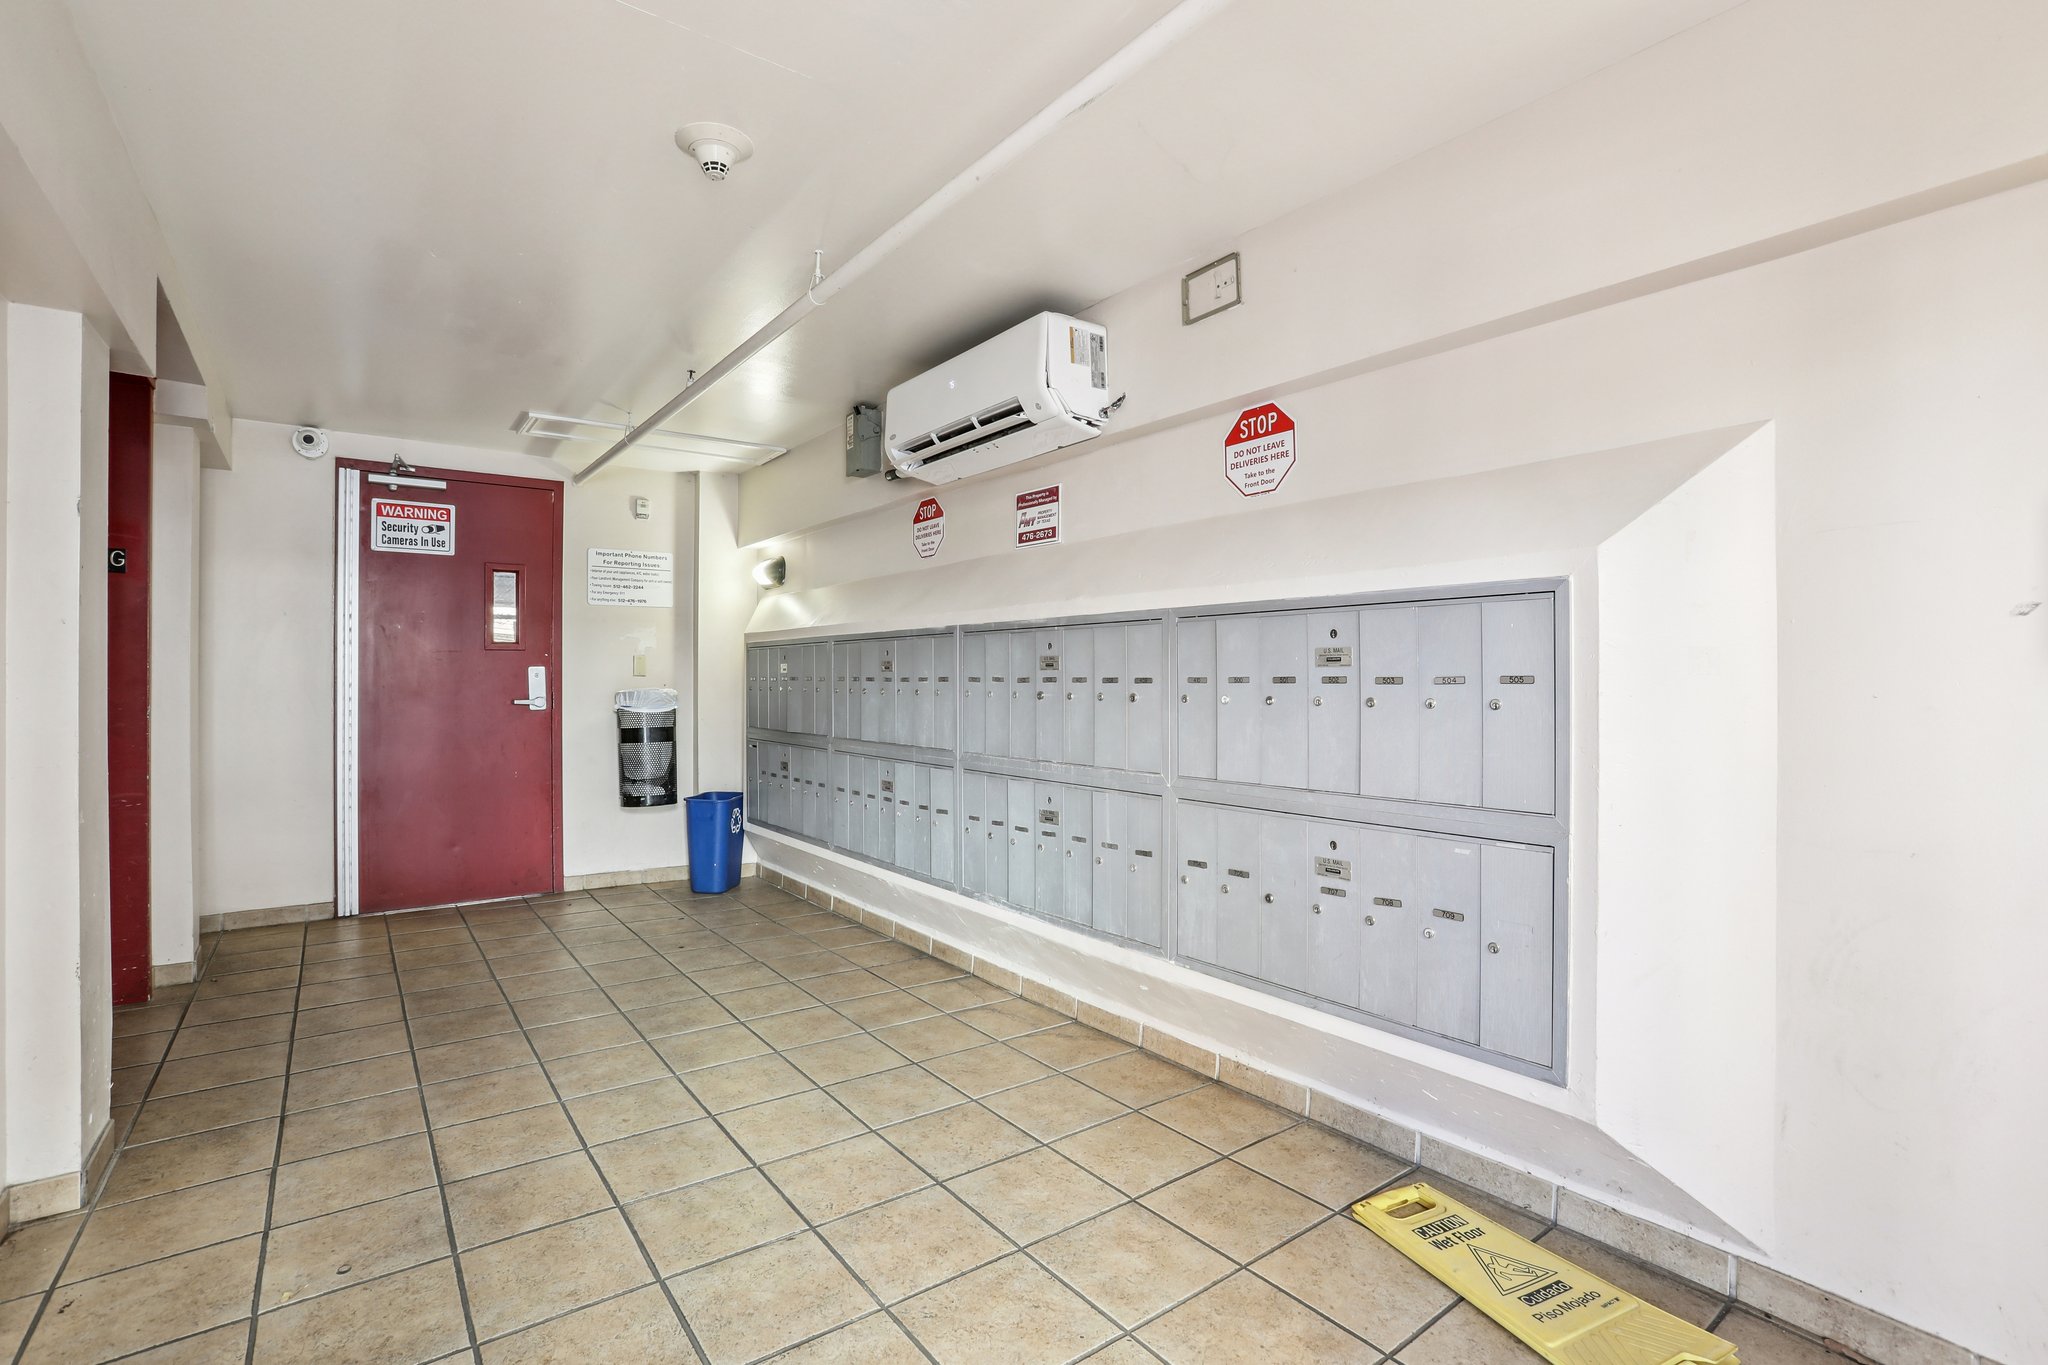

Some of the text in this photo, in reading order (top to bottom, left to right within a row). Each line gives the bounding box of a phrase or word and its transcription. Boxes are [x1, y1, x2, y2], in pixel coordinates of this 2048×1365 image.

[1240, 412, 1278, 439] STOP
[1234, 440, 1285, 458] DO NOT LEAVE
[1230, 450, 1290, 470] DELIVERIES HERE
[381, 505, 447, 520] WARNING
[920, 504, 936, 520] STOP
[382, 521, 419, 535] Security
[1022, 529, 1052, 540] 476-2673
[382, 534, 446, 548] Cameras In Use
[110, 550, 125, 566] G
[1442, 911, 1455, 919] 709
[1414, 1215, 1467, 1238] CAUTION
[1428, 1227, 1486, 1250] Wet Floor
[1521, 1282, 1570, 1305] Cuidado
[1532, 1290, 1601, 1323] Piso Mojado
